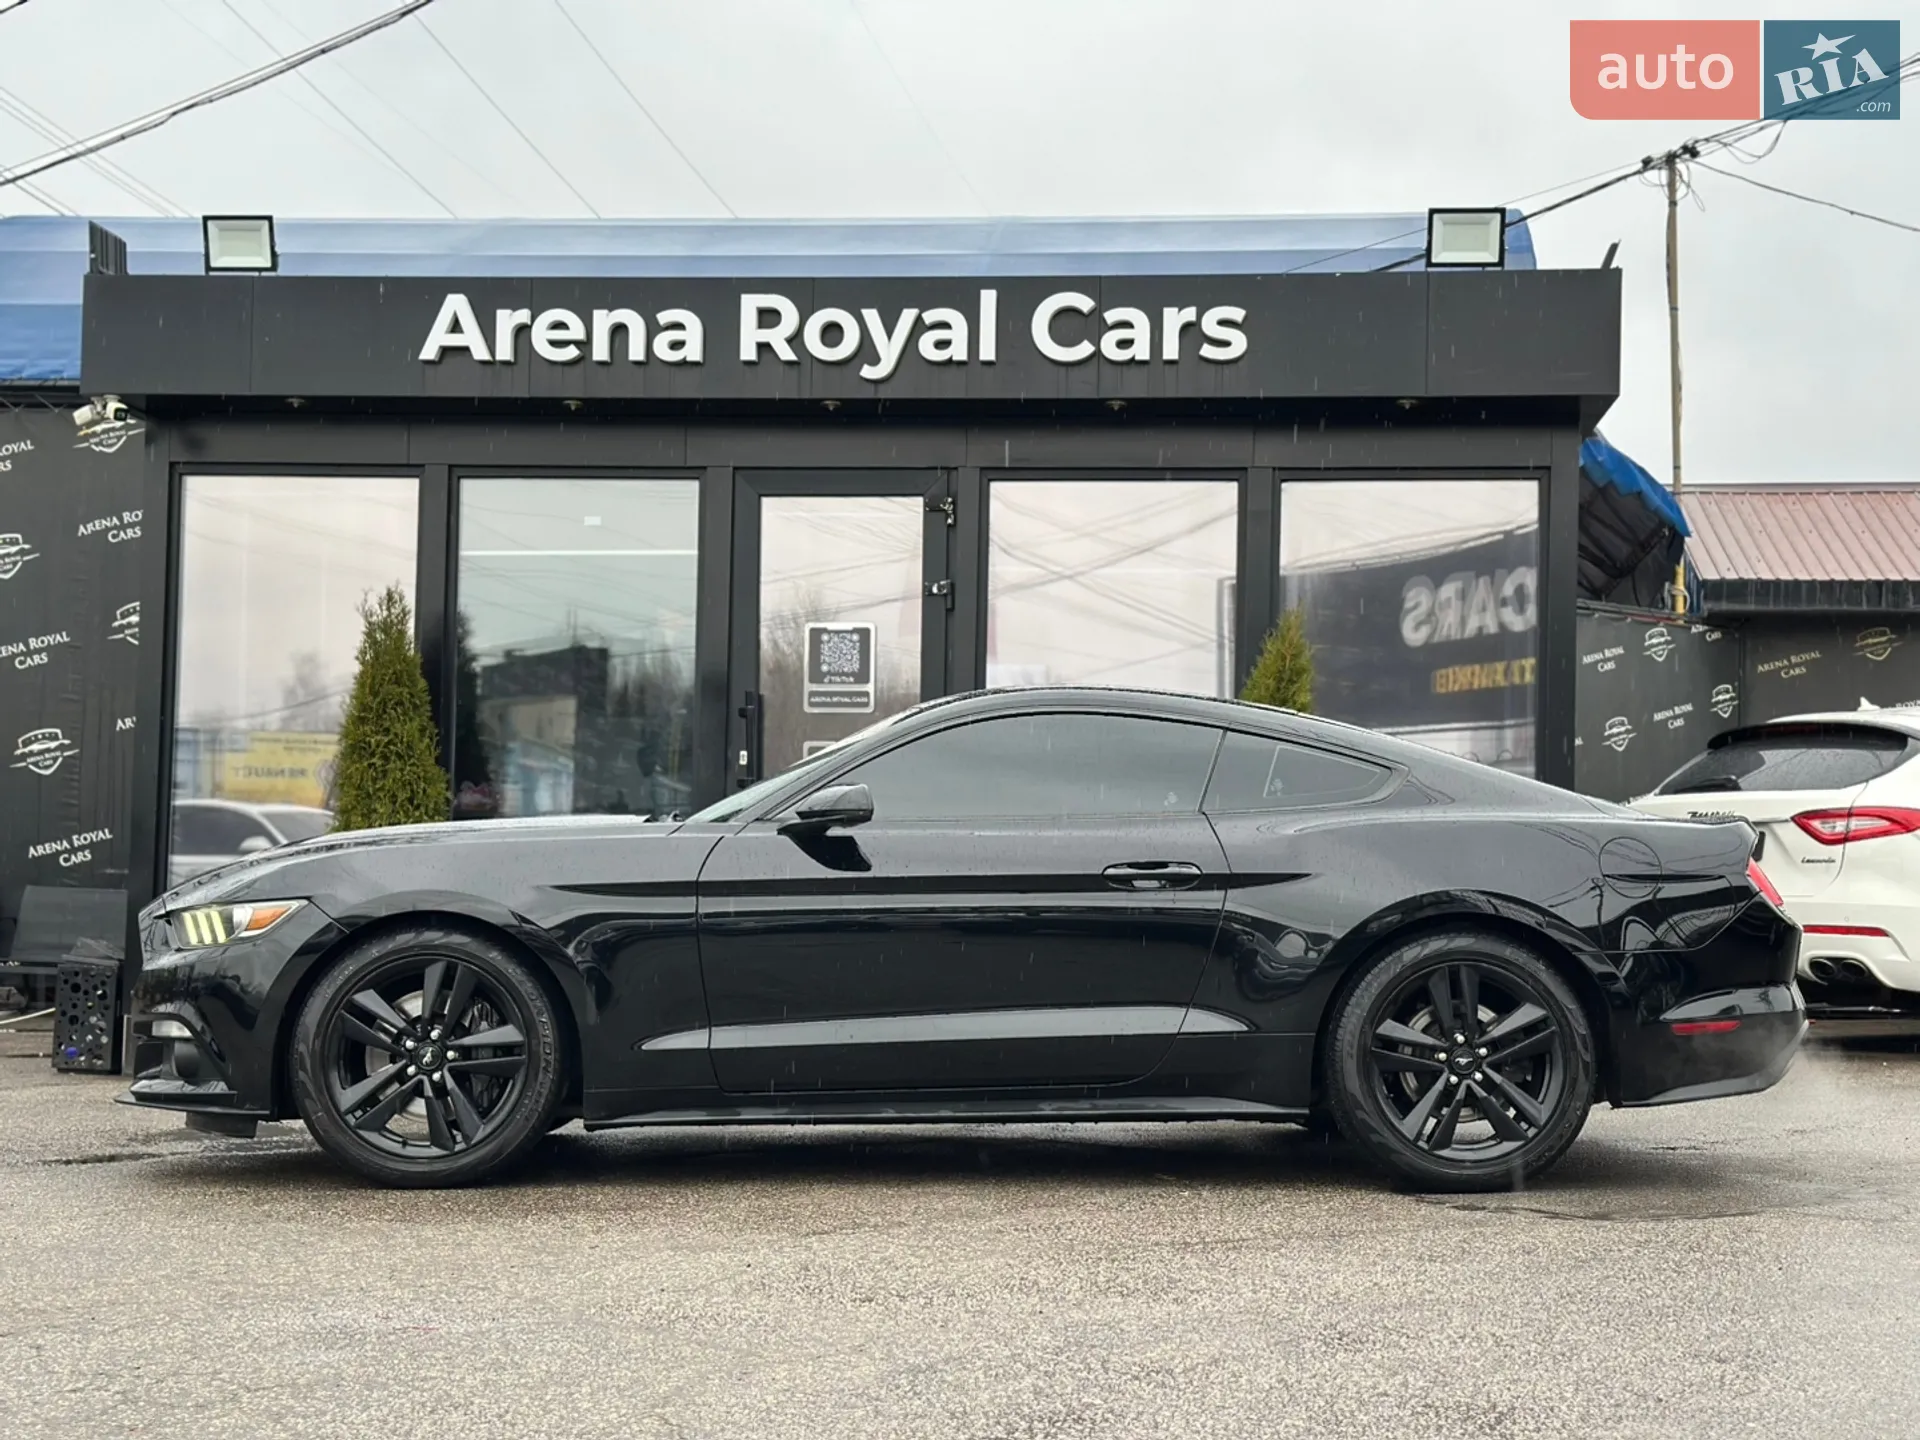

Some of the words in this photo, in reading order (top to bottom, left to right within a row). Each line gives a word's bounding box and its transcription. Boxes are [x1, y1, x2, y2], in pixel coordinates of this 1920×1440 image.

[418, 292, 704, 365] Arena
[738, 289, 998, 382] Royal
[1030, 290, 1248, 364] Cars
[77, 516, 120, 537] ARENA
[122, 509, 144, 524] RO
[107, 526, 142, 543] CARS
[28, 631, 71, 650] ROYAL
[14, 652, 48, 670] CARS
[1597, 660, 1616, 673] CARS
[1757, 659, 1789, 673] ARENA
[1790, 650, 1822, 665] ROYAL
[1780, 666, 1807, 679] CARS
[115, 716, 137, 731] AR
[28, 840, 71, 859] ARENA
[72, 828, 114, 847] ROYAL
[59, 849, 92, 867] CARS
